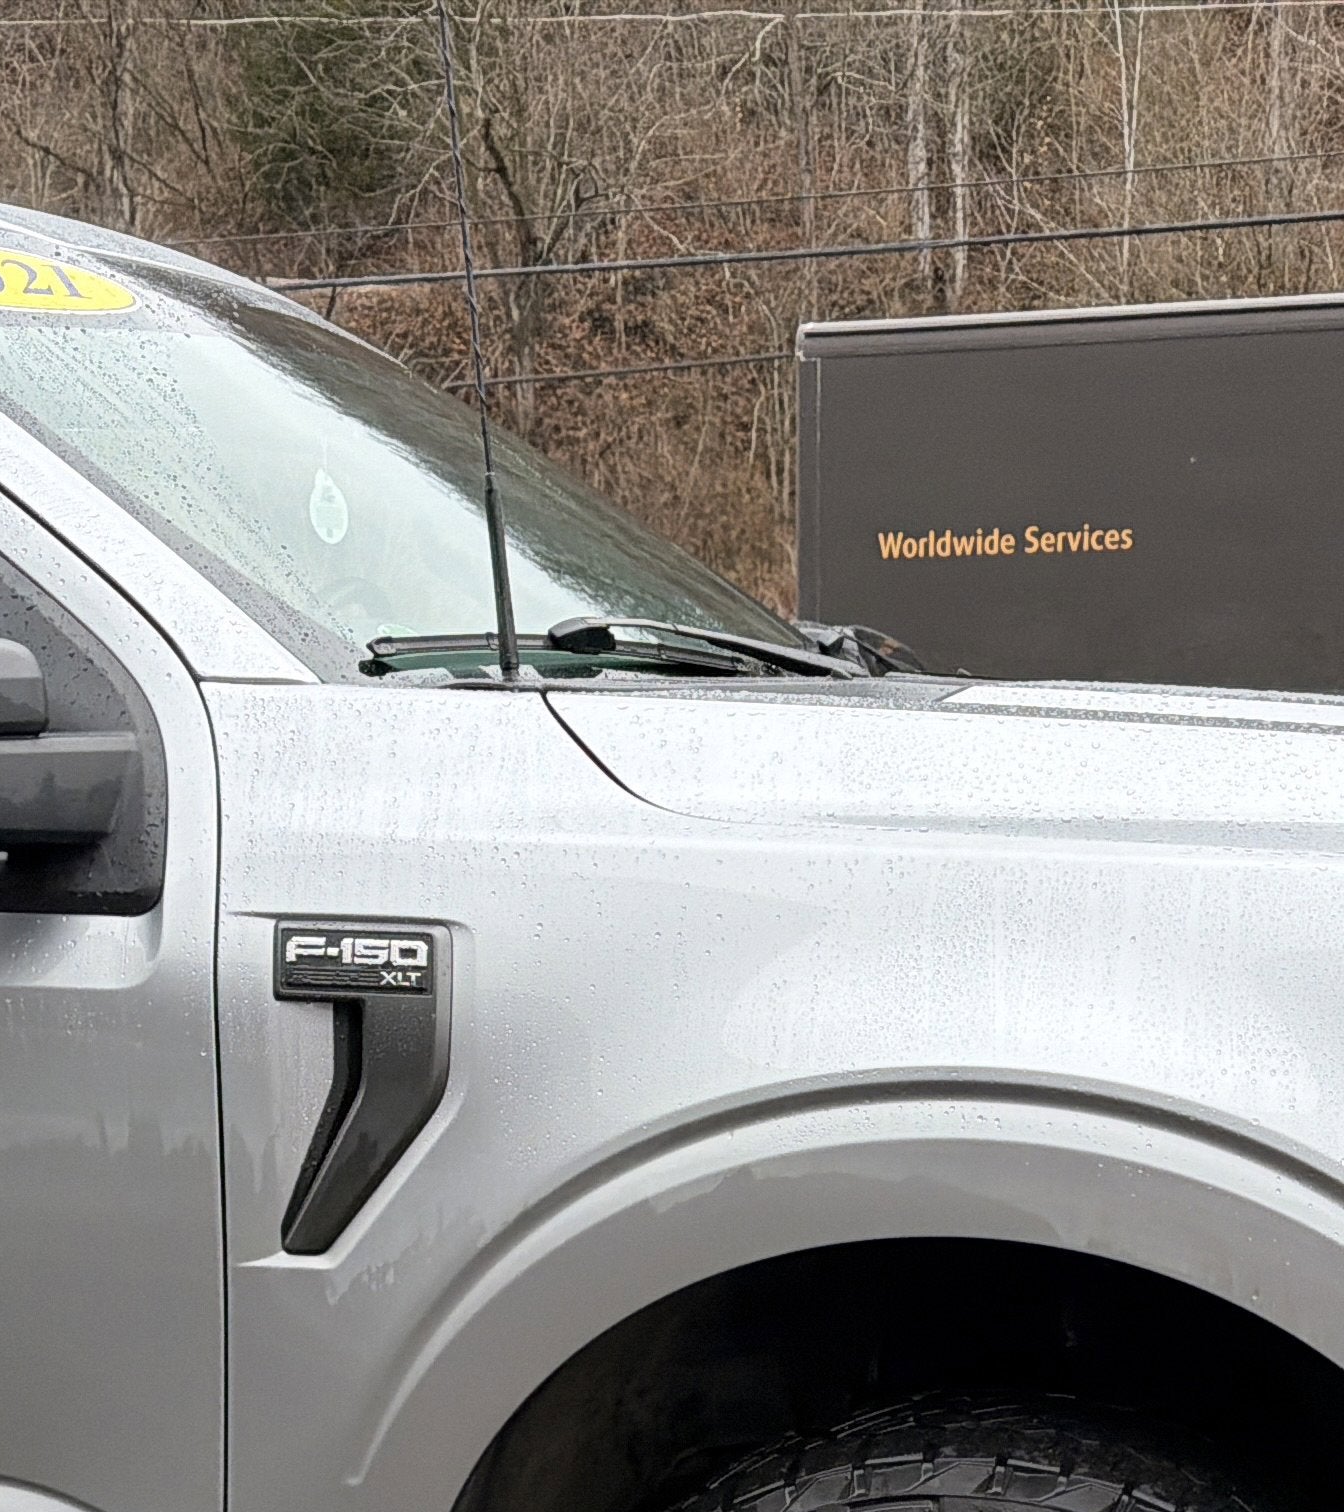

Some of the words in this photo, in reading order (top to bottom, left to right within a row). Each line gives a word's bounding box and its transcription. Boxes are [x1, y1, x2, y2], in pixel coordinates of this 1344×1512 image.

[877, 528, 1016, 560] Worldwide
[1023, 513, 1133, 554] Services
[285, 936, 428, 967] F-150
[379, 971, 422, 987] XLT
